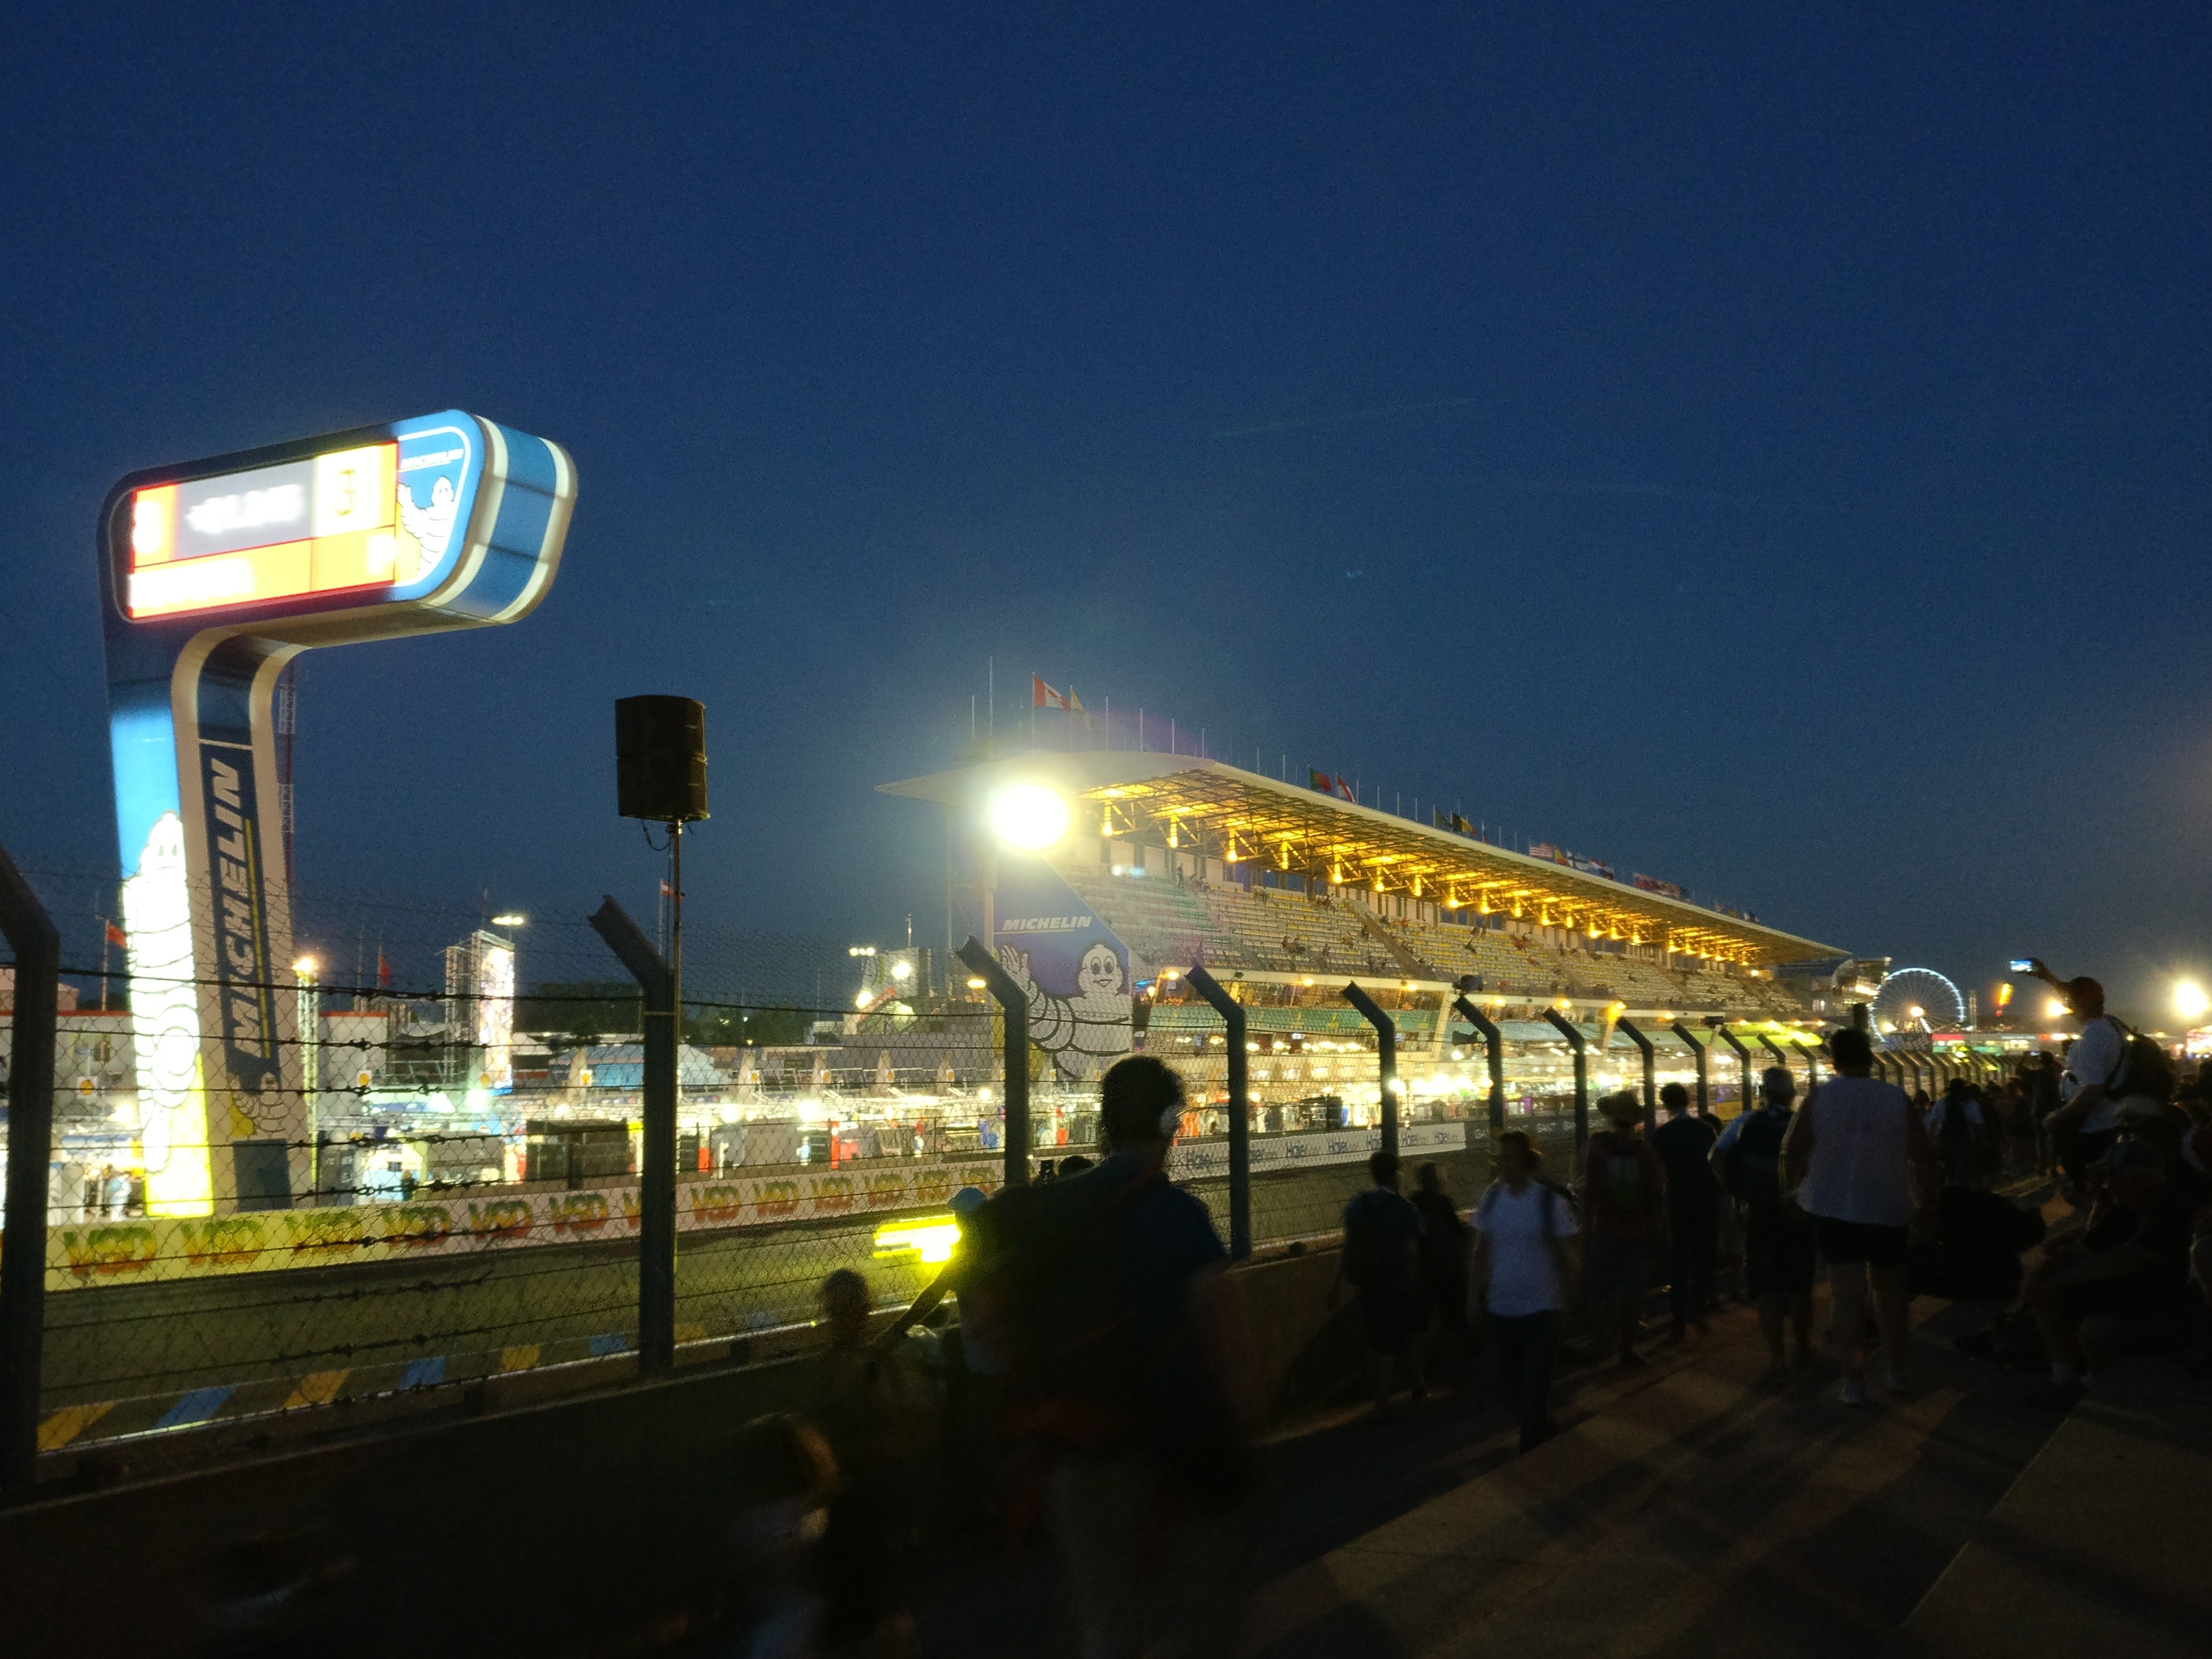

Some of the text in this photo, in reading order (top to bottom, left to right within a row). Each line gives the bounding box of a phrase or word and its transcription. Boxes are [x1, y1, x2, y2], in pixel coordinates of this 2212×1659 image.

[211, 757, 262, 1057] MICHELIN
[1003, 916, 1092, 931] MICHELIN
[690, 1186, 739, 1221] VSD
[753, 1181, 799, 1217] VSD
[810, 1176, 853, 1210] VSD
[863, 1173, 904, 1206] VSD
[468, 1200, 531, 1240] VSD
[549, 1193, 608, 1233] VSD
